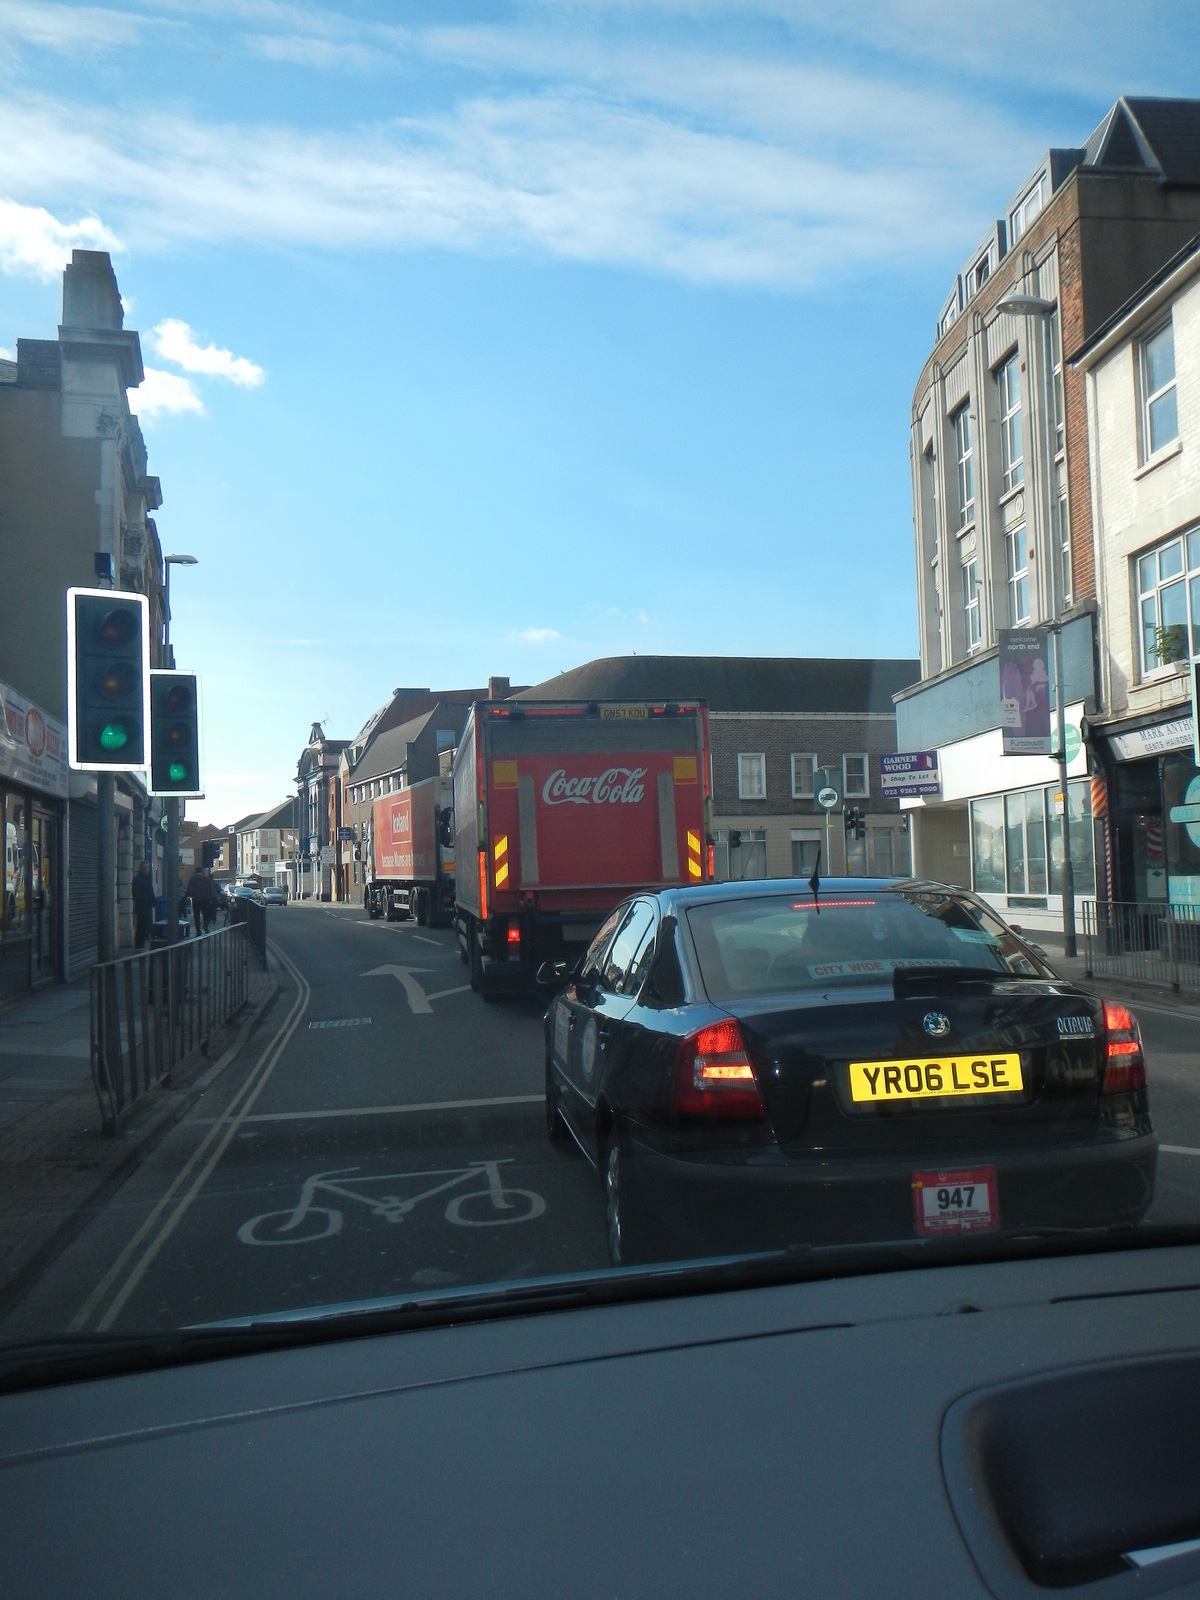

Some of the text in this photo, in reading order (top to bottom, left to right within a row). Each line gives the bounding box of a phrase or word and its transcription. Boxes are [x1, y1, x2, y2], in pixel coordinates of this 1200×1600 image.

[1139, 726, 1164, 742] MARK
[1145, 741, 1165, 752] GENTS
[883, 756, 917, 764] GARNER
[542, 768, 648, 805] Coca-Cola
[392, 810, 409, 834] Iceland
[814, 964, 845, 976] CITY
[847, 961, 884, 972] WIDE
[863, 1060, 1010, 1095] YR06 LSE
[937, 1186, 975, 1210] 947
